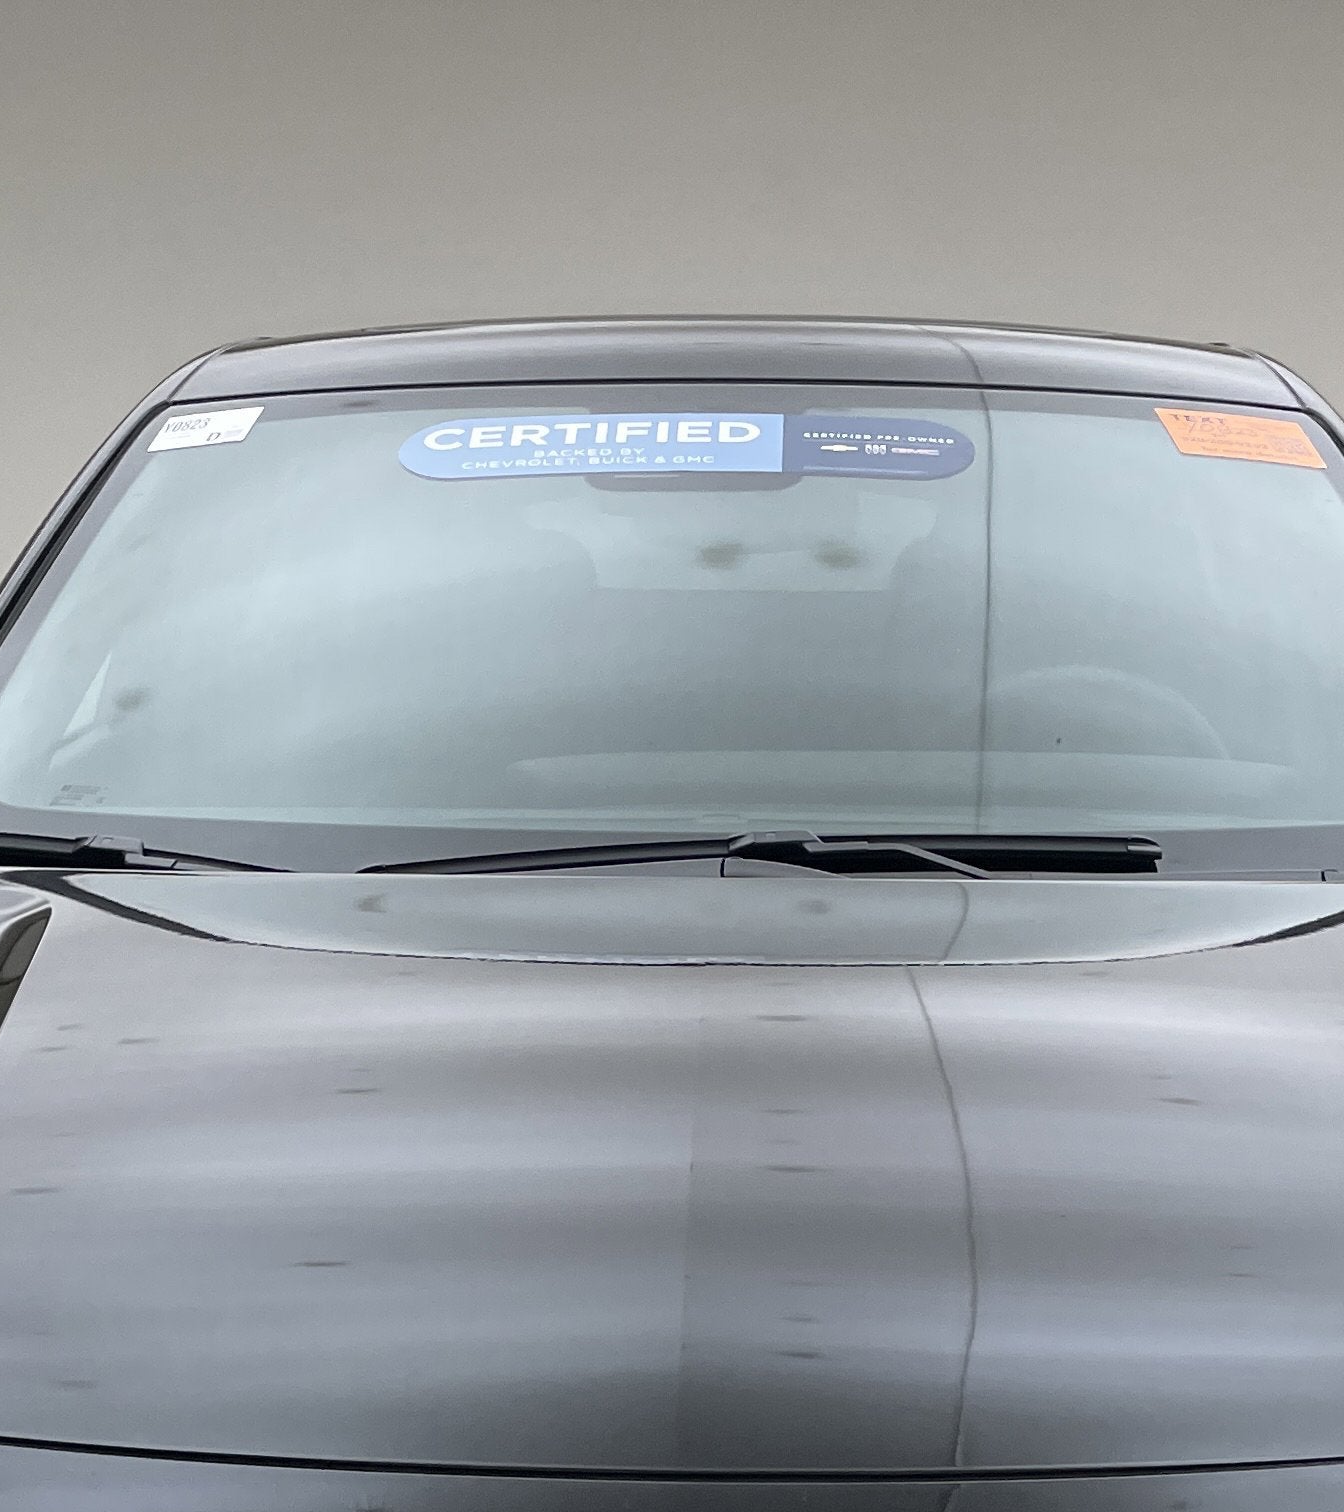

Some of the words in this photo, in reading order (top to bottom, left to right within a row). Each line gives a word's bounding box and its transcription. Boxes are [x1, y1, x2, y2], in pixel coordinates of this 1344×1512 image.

[423, 421, 761, 451] CERTIFIED
[533, 448, 613, 458] BACKED
[619, 448, 645, 456] BY
[588, 456, 648, 465] BUICK
[654, 456, 666, 465] &
[672, 455, 715, 464] GMC
